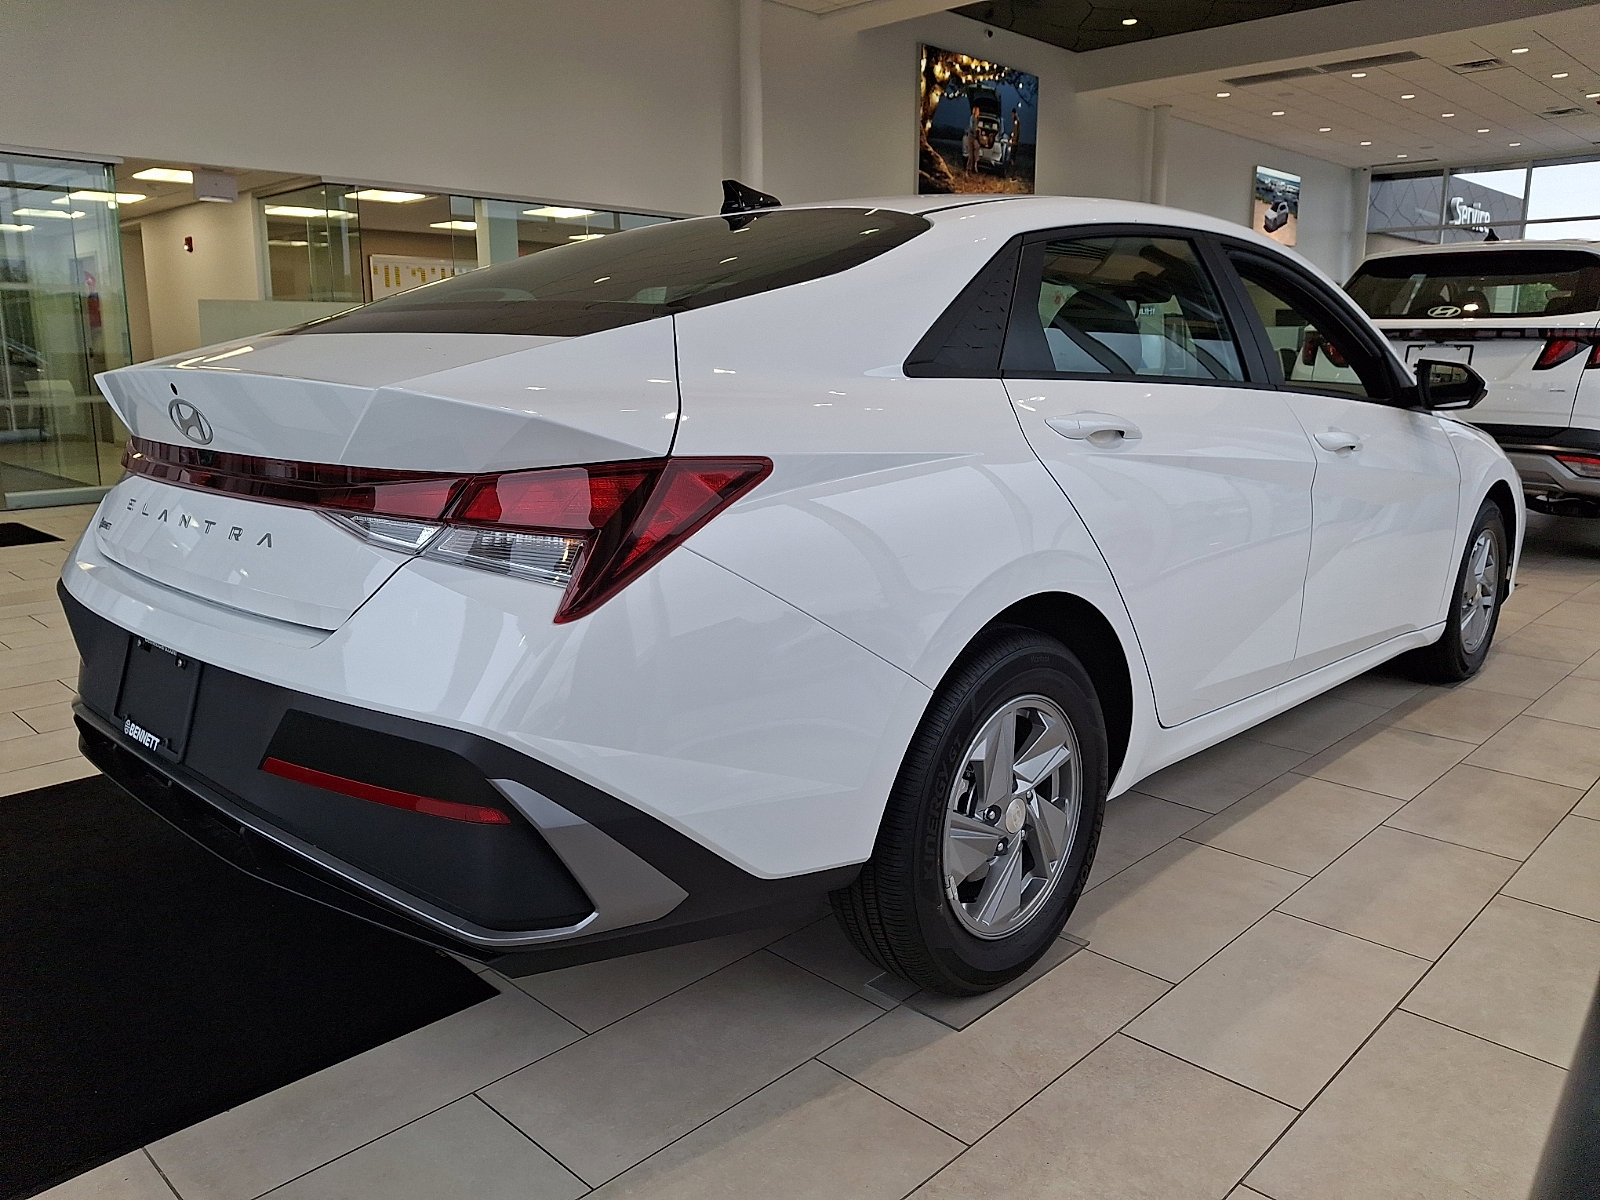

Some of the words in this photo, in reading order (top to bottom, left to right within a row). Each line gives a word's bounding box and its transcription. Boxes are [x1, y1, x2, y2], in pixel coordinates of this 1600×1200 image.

[1448, 196, 1491, 233] Service
[126, 498, 272, 548] ELANTRA
[128, 723, 160, 752] BENNETT
